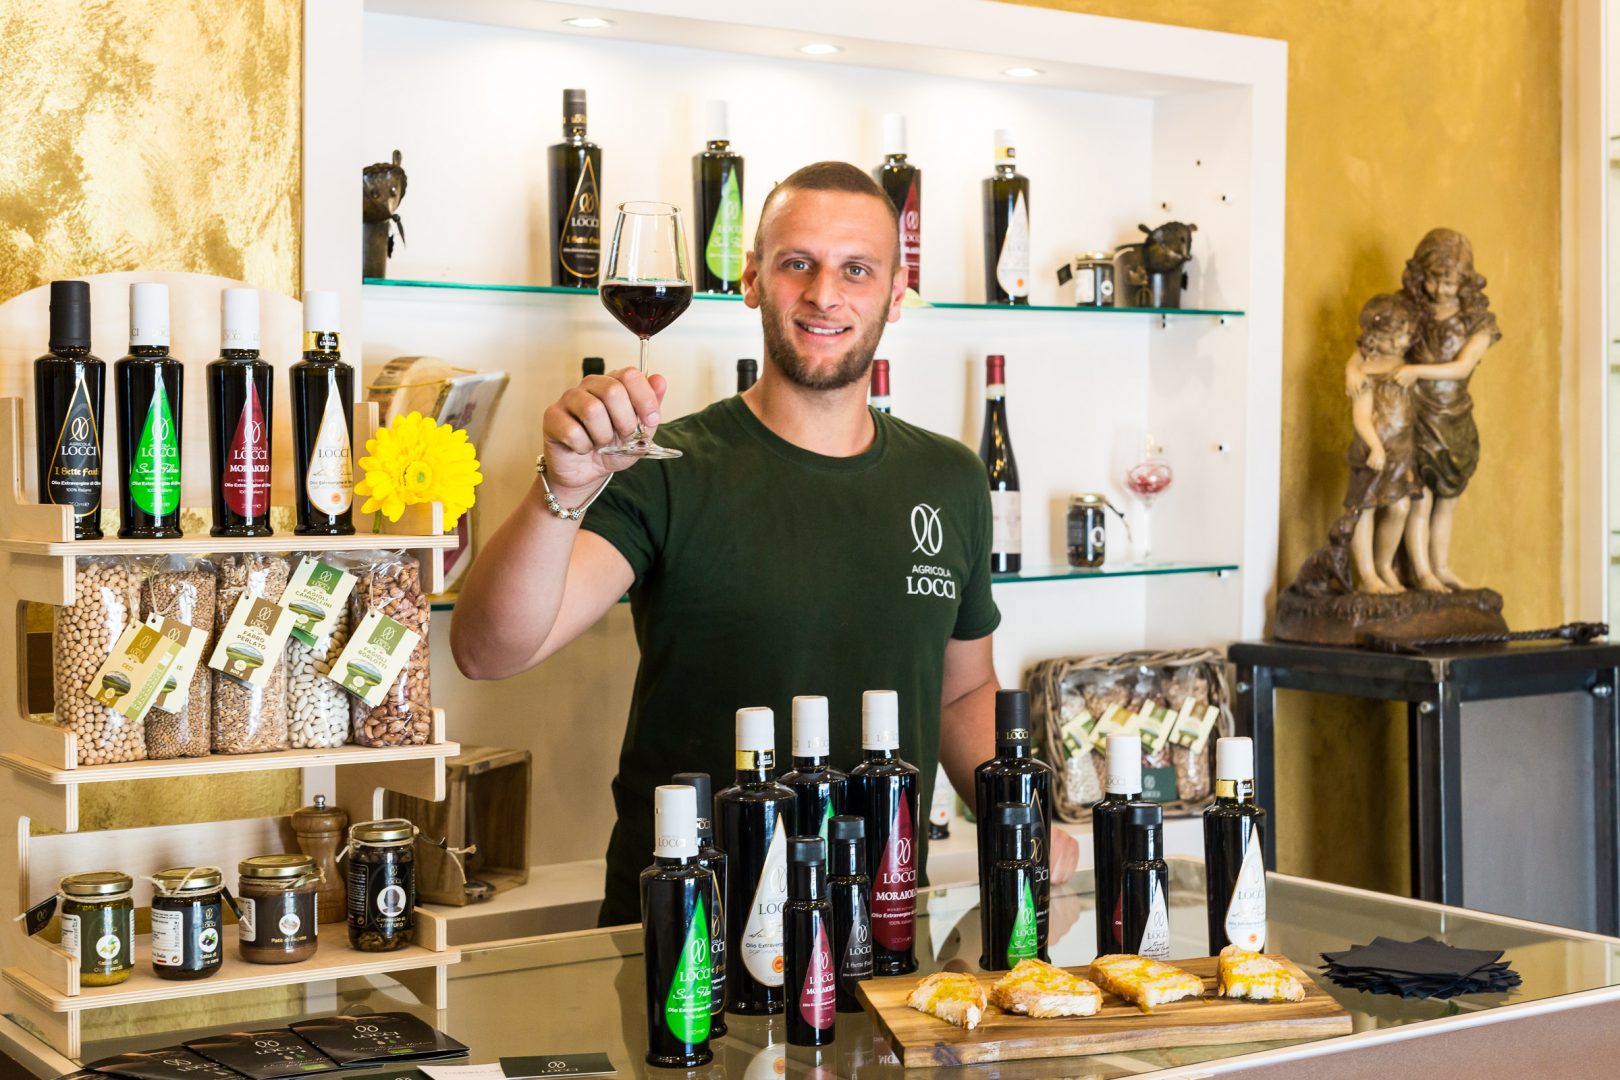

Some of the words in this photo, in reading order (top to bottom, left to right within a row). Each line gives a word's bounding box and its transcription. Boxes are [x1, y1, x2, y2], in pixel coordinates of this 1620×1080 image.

[61, 446, 96, 456] LOCCI
[912, 565, 951, 578] AGRICOLA
[906, 576, 956, 599] LOCCI
[296, 591, 332, 608] CANNELLINI
[304, 589, 329, 602] FAGIOLI
[237, 634, 266, 650] PERLATO
[358, 650, 387, 670] BORLOTTI
[363, 646, 387, 663] FAGIOLI
[883, 870, 916, 884] LOCCI
[680, 967, 710, 982] LOCCI
